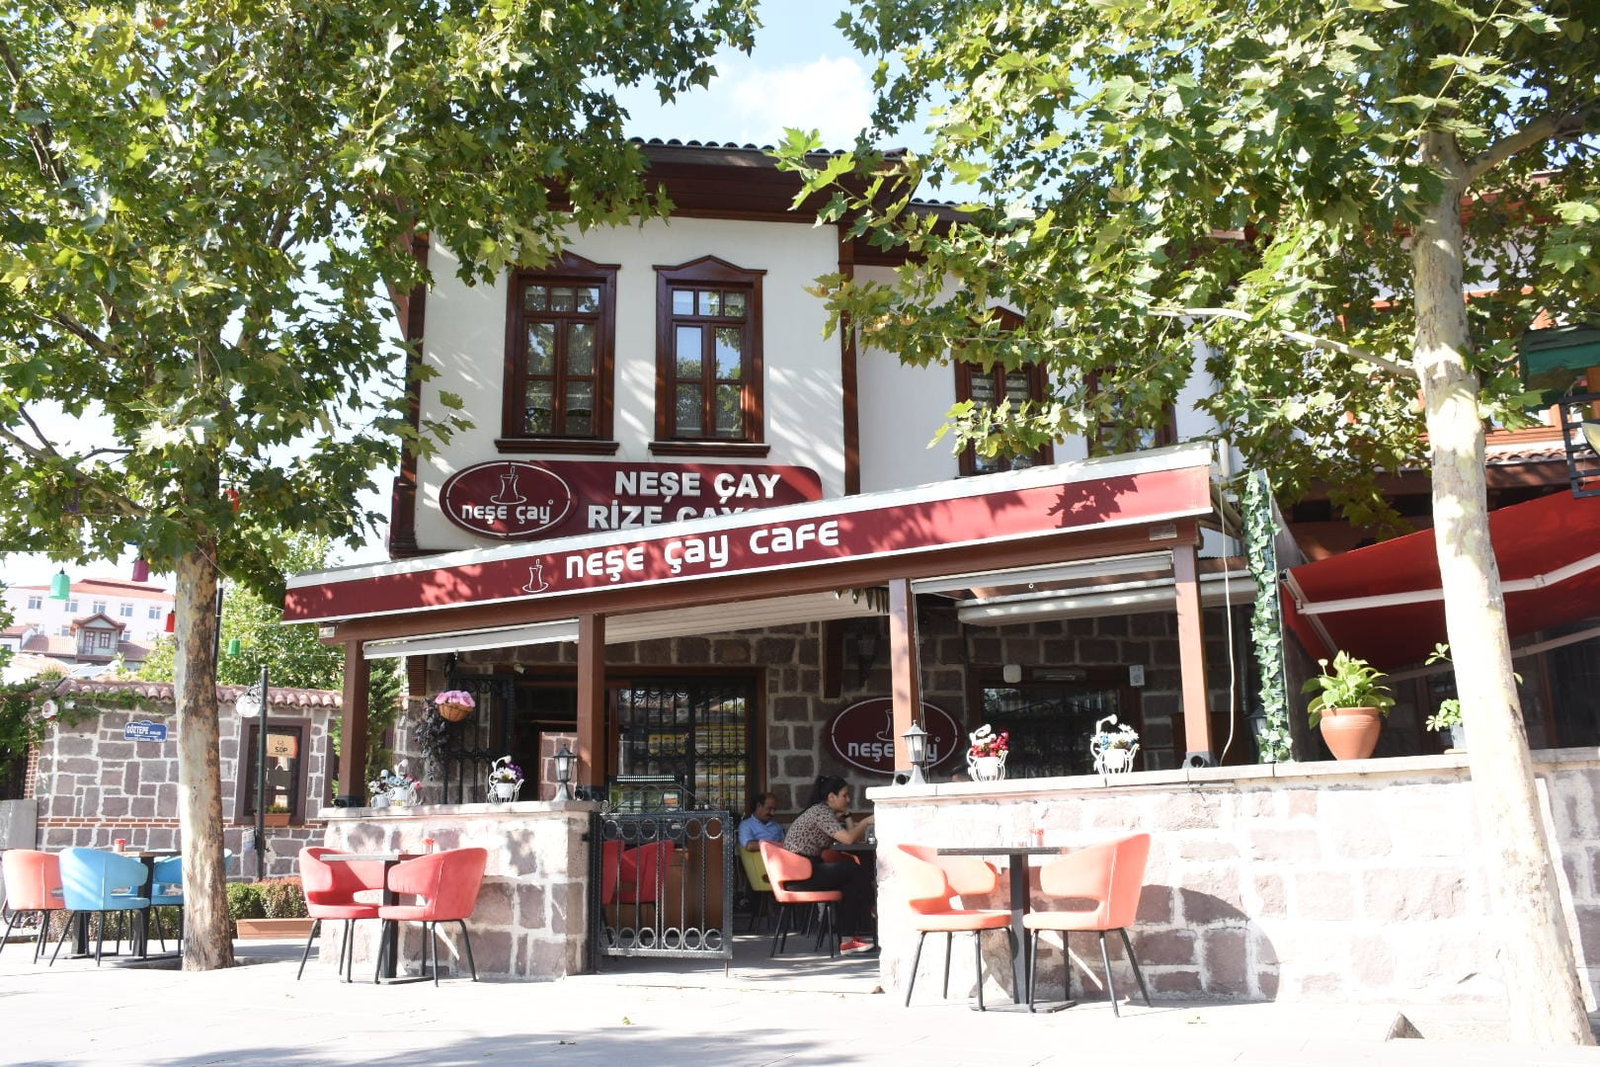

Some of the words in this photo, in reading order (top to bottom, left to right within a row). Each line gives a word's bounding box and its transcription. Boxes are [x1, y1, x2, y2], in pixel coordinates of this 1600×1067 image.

[615, 471, 700, 503] NEŞE
[714, 473, 781, 504] ÇAY
[462, 505, 507, 524] neşe
[588, 500, 662, 529] RİZE
[566, 546, 644, 582] neşe
[664, 535, 728, 574] çay
[847, 742, 894, 762] neşe
